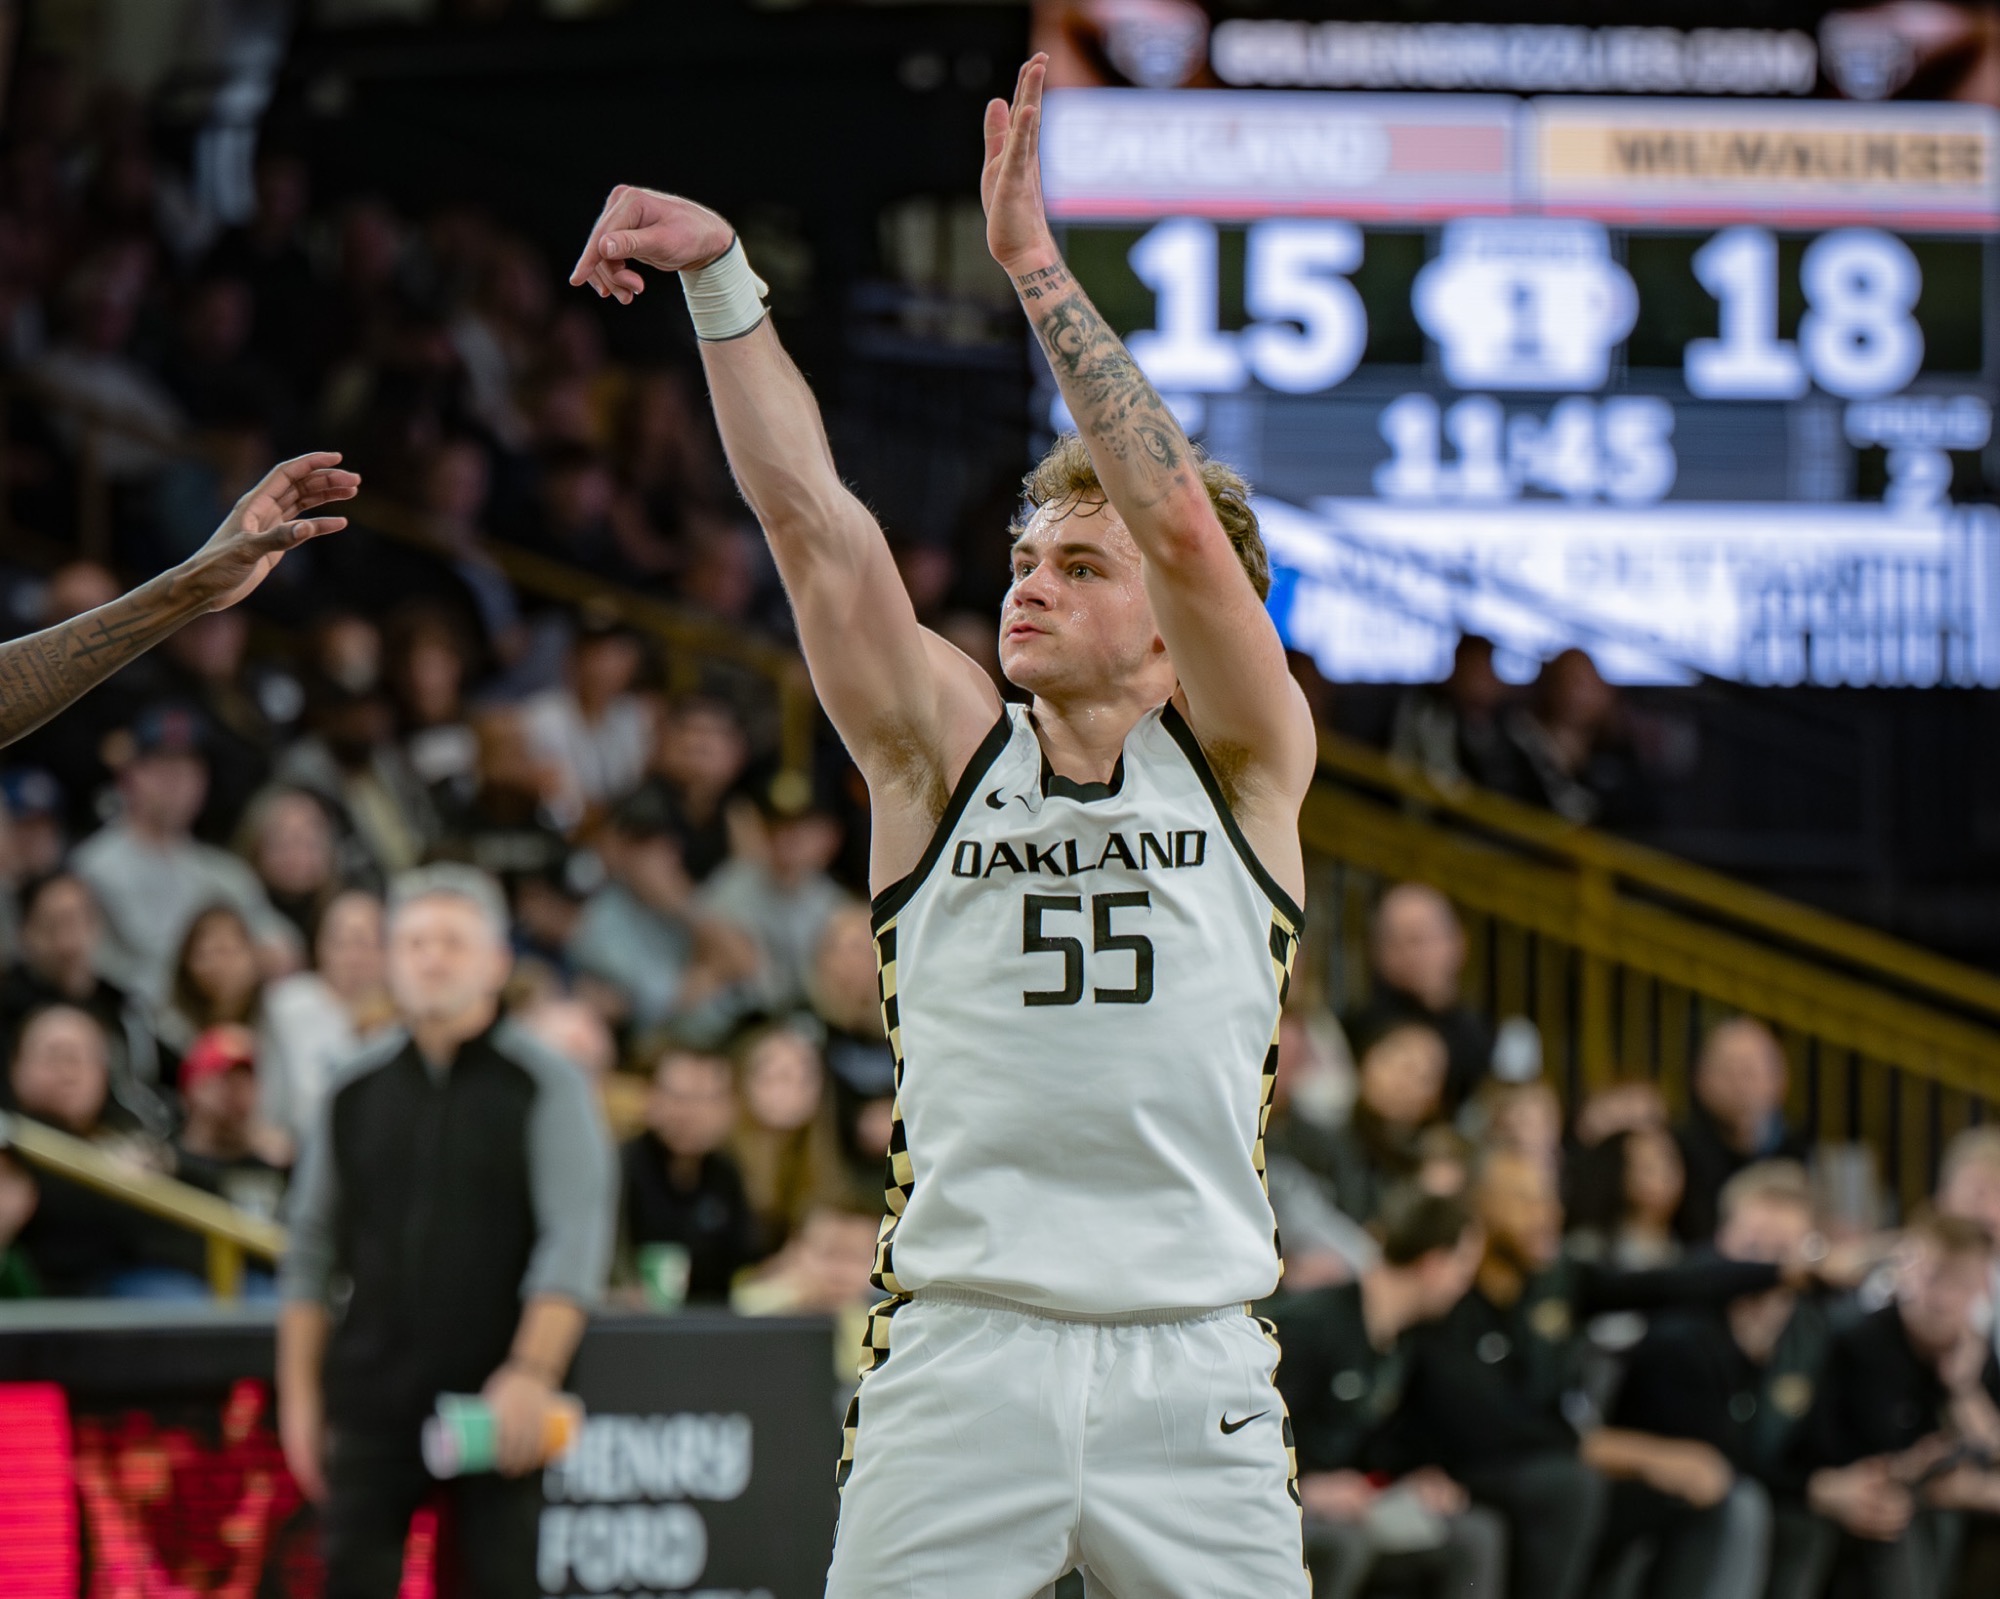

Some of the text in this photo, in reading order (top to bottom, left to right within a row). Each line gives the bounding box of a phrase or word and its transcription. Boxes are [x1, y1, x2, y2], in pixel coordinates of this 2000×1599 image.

[1124, 216, 1367, 393] 15
[1684, 226, 1924, 398] 18
[1372, 394, 1676, 502] 11:45
[951, 830, 1207, 879] OAKLAND
[1023, 891, 1154, 1007] 55
[537, 1503, 708, 1593] FORD
